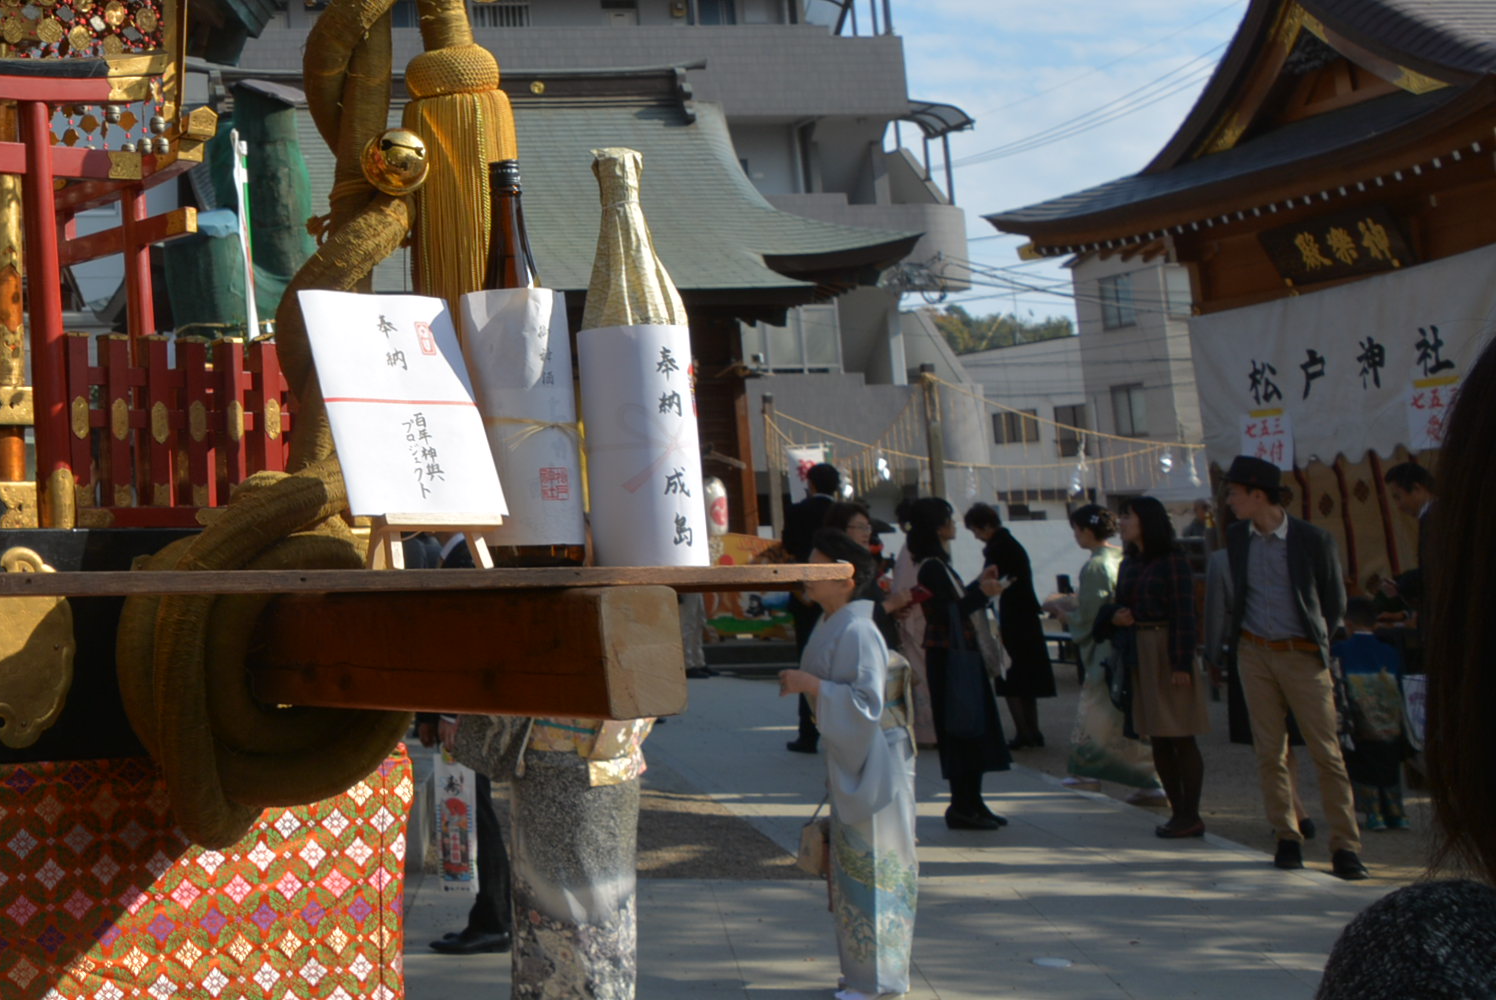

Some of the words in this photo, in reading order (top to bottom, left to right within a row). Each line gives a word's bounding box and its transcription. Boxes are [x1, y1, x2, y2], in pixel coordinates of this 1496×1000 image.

[376, 314, 407, 370] 奉納
[1248, 325, 1456, 405] 松戸神社
[656, 346, 683, 417] 奉納
[1245, 417, 1285, 439] 七五三
[664, 466, 693, 547] 成島
